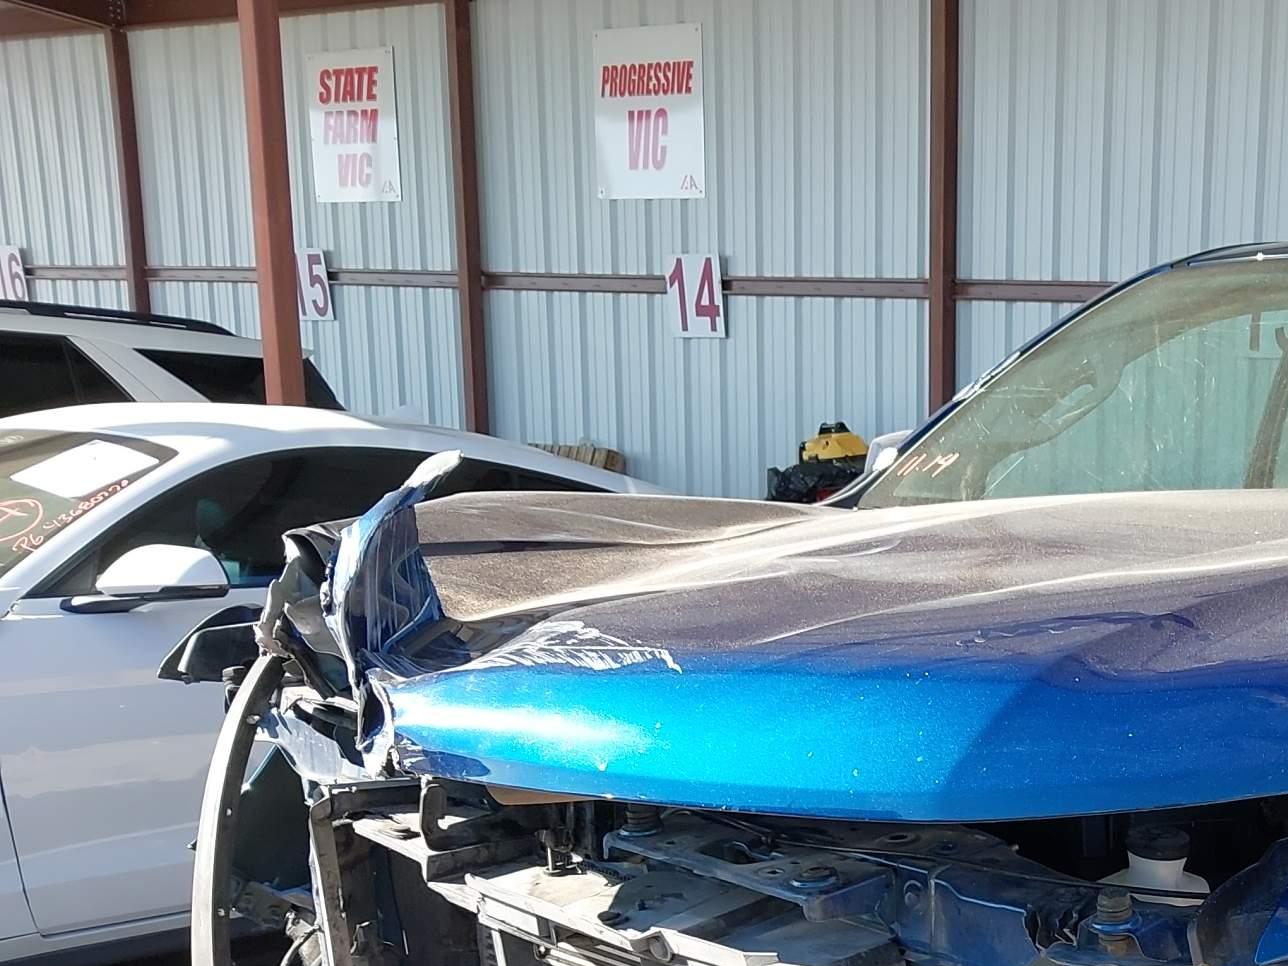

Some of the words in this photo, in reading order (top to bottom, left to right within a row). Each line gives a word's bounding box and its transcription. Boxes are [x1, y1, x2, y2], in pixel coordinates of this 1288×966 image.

[319, 65, 379, 105] STATE
[601, 60, 695, 98] PROGRESSIVE
[323, 108, 379, 145] FARM
[626, 107, 669, 171] VIC
[337, 152, 373, 189] VIC
[668, 256, 721, 332] 14
